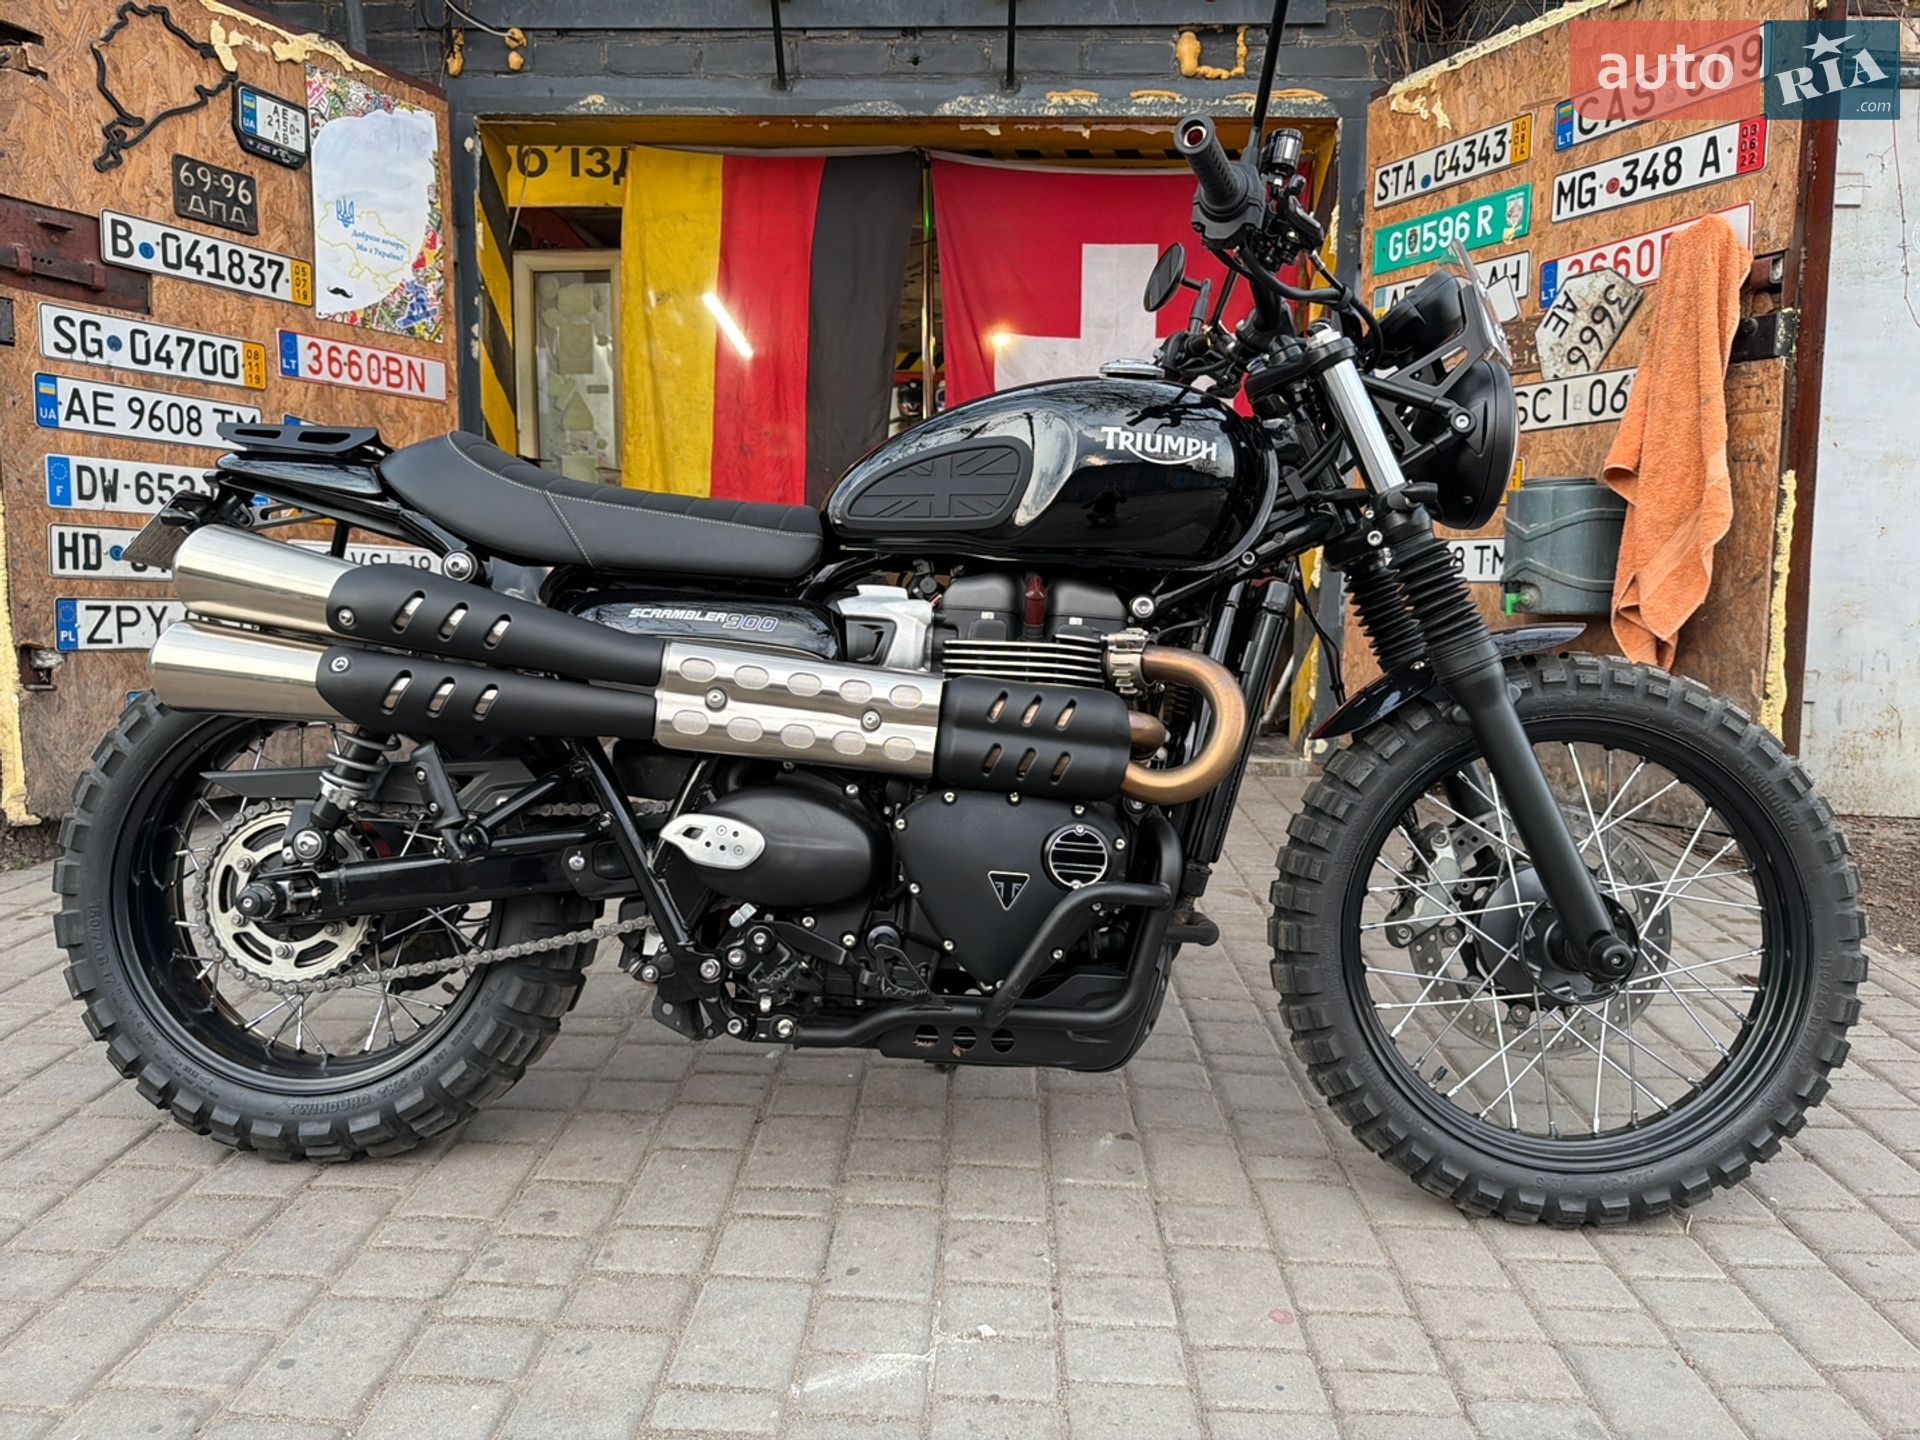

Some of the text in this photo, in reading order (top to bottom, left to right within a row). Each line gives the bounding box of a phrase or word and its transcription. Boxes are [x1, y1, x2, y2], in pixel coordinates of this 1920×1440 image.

[242, 118, 256, 129] UA
[1741, 122, 1757, 138] 03
[1558, 132, 1571, 146] LT
[1740, 137, 1757, 152] 06
[1377, 128, 1508, 201] STA 04343
[1739, 152, 1757, 168] 22
[1556, 136, 1721, 215] MG 348 A
[188, 194, 248, 227] ДПД
[1388, 204, 1494, 263] G 596 R
[110, 218, 285, 293] B 041837
[1541, 288, 1556, 300] LT
[53, 315, 240, 380] SG 04700
[282, 358, 297, 370] LT
[39, 409, 57, 420] UA
[64, 387, 117, 428] AE
[127, 396, 203, 437] 9608
[1101, 426, 1218, 464] TRIUMPH
[56, 485, 64, 497] F
[58, 531, 103, 571] HD
[85, 605, 168, 645] ZPY
[628, 607, 779, 632] SCRAMBLER 900
[60, 630, 76, 642] PL
